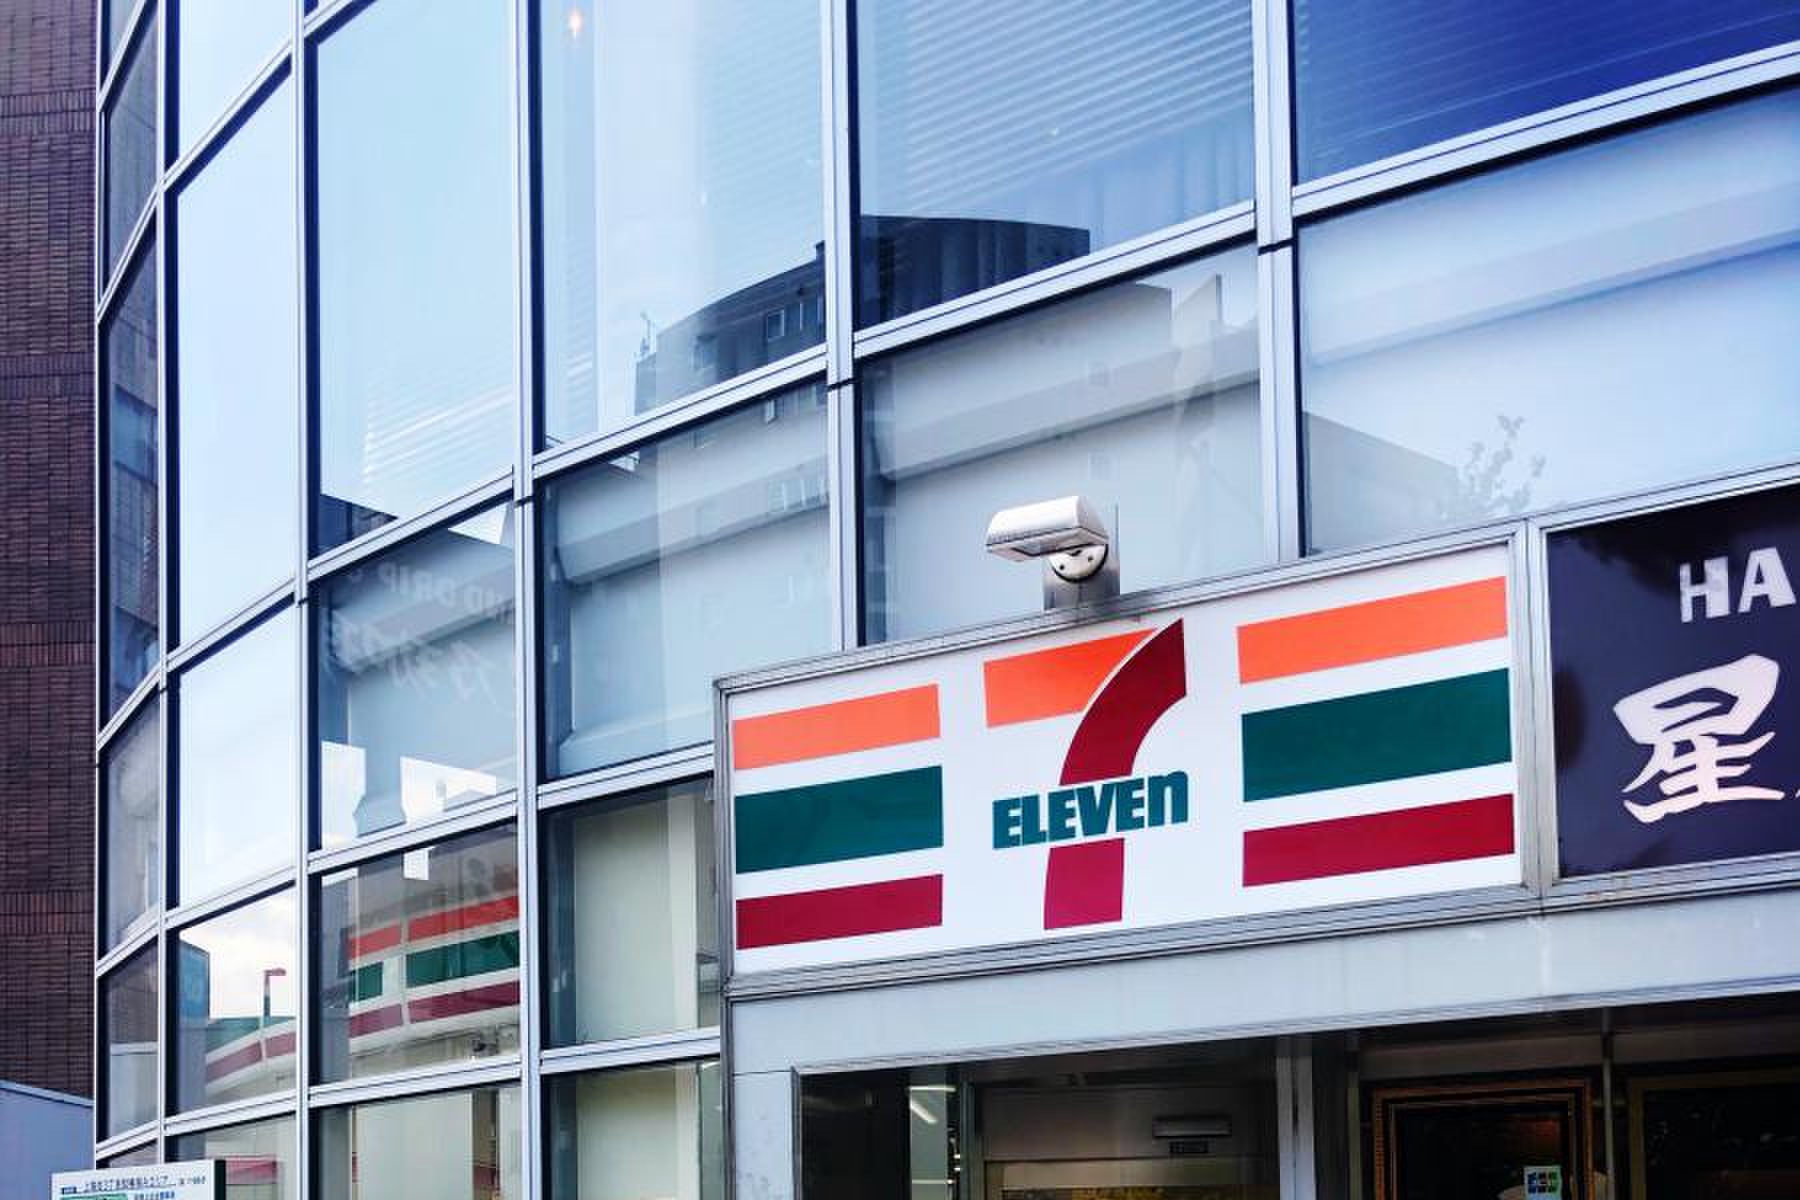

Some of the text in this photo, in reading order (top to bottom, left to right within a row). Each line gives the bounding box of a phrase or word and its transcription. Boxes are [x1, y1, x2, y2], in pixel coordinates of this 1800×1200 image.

[1679, 546, 1797, 624] HA
[983, 617, 1187, 931] 7
[1612, 652, 1785, 825] 星
